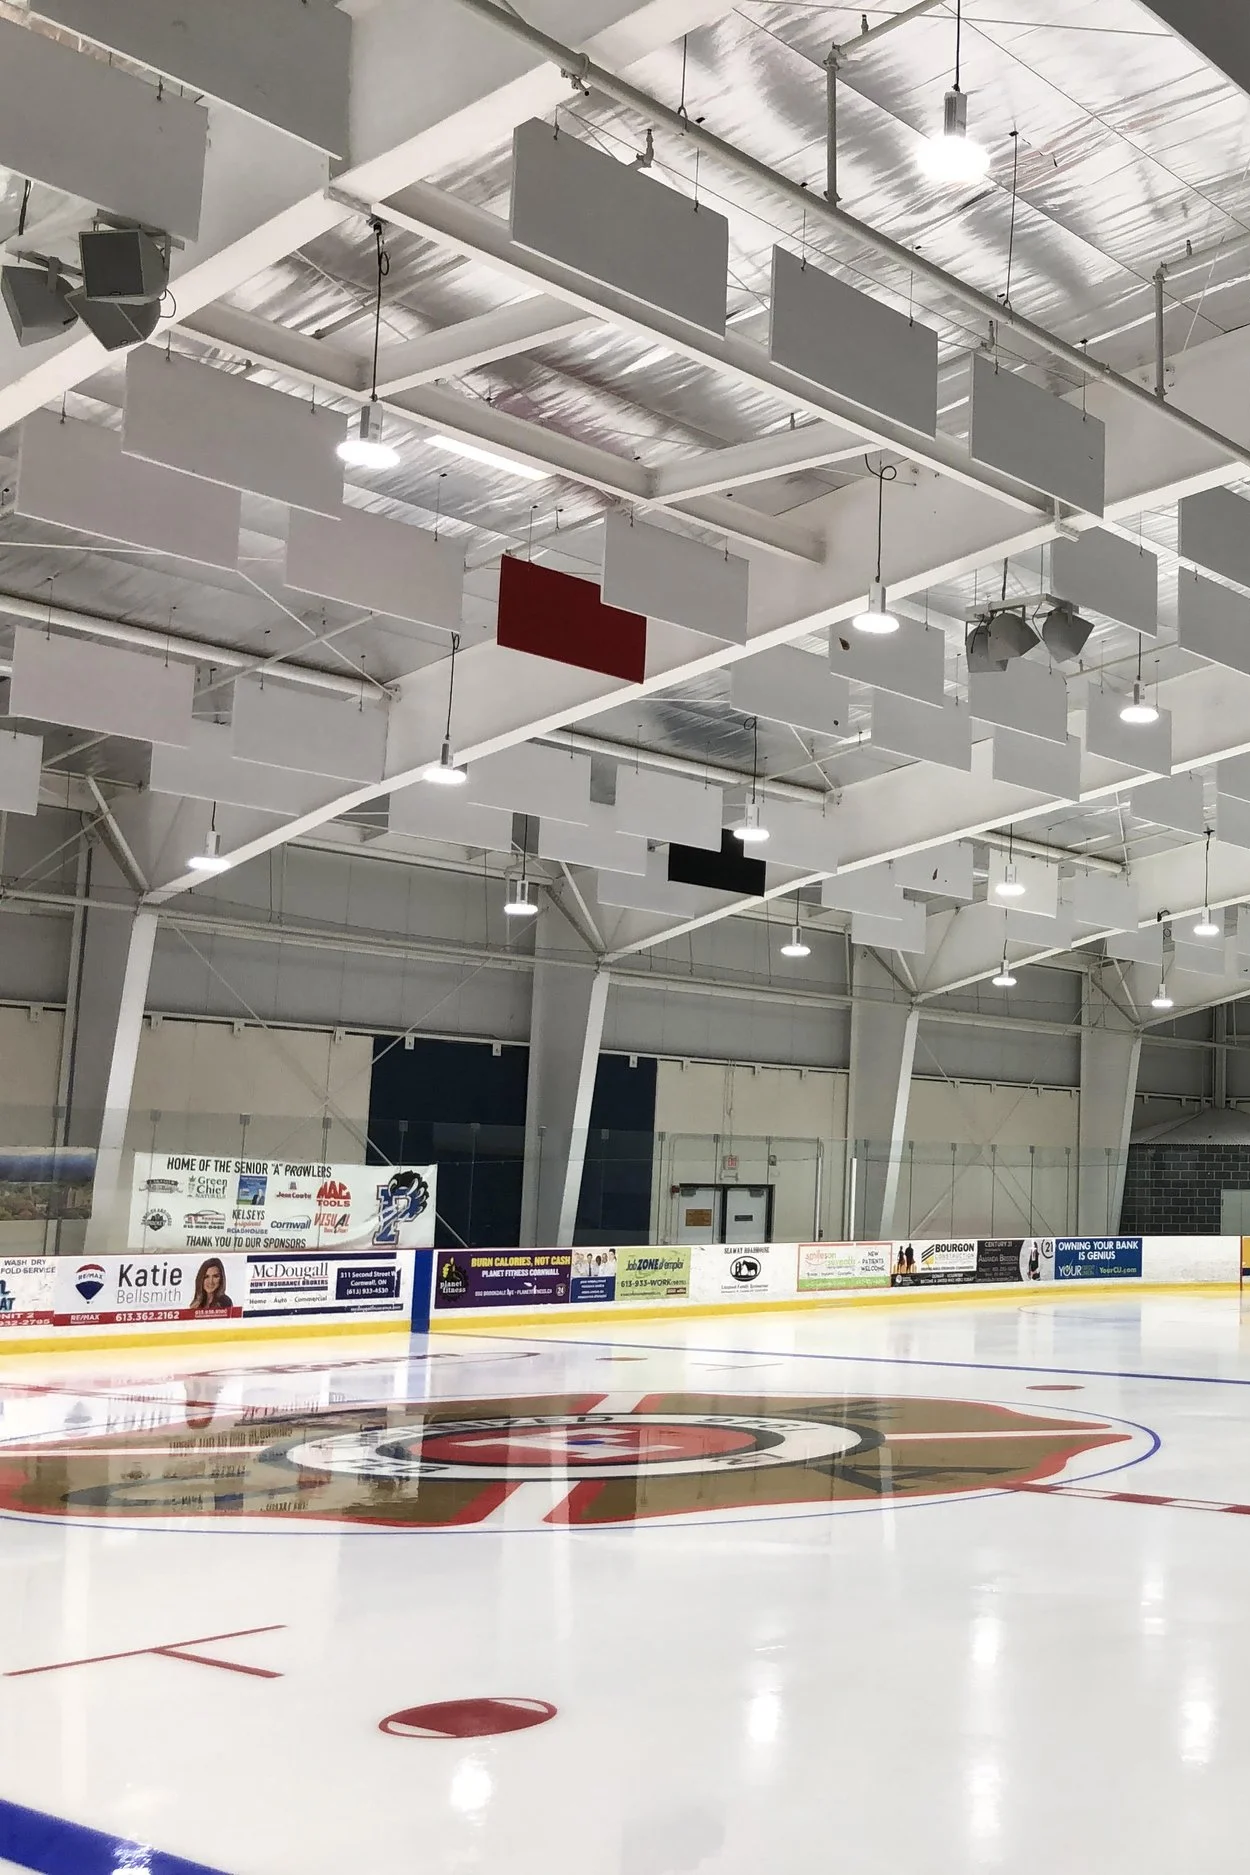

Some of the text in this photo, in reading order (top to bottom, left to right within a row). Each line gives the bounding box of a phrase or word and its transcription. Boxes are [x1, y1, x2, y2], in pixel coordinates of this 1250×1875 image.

[167, 1157, 196, 1171] HOME
[199, 1158, 210, 1172] OF
[214, 1159, 231, 1173] THE
[234, 1161, 268, 1175] SENIOR
[284, 1164, 332, 1178] PROWLERS
[198, 1175, 228, 1187] Green
[196, 1184, 227, 1195] Chief
[316, 1180, 351, 1199] MAC
[232, 1209, 265, 1220] KELSEYS
[271, 1219, 312, 1229] Cornwall
[314, 1212, 350, 1230] VISUAL
[186, 1235, 306, 1249] THANK YOU TO OUR SPONSORS
[935, 1243, 974, 1252] BOURGON
[1058, 1240, 1139, 1251] OWNING YOUR BANK
[471, 1255, 571, 1267] BURN CALORIES, NOT CASH
[1078, 1251, 1116, 1260] IS GENIUS
[119, 1262, 182, 1288] Katie
[252, 1262, 329, 1280] McDougall
[481, 1268, 559, 1278] PLANET FITNESS CORNWALL
[1058, 1265, 1082, 1276] YOUR
[267, 1279, 301, 1287] INSURANCE
[440, 1280, 462, 1289] planet
[116, 1288, 182, 1305] Bellsmith
[295, 1295, 328, 1304] Commercial
[70, 1314, 100, 1322] RE/MAX
[115, 1310, 180, 1322] 613.362.2162
